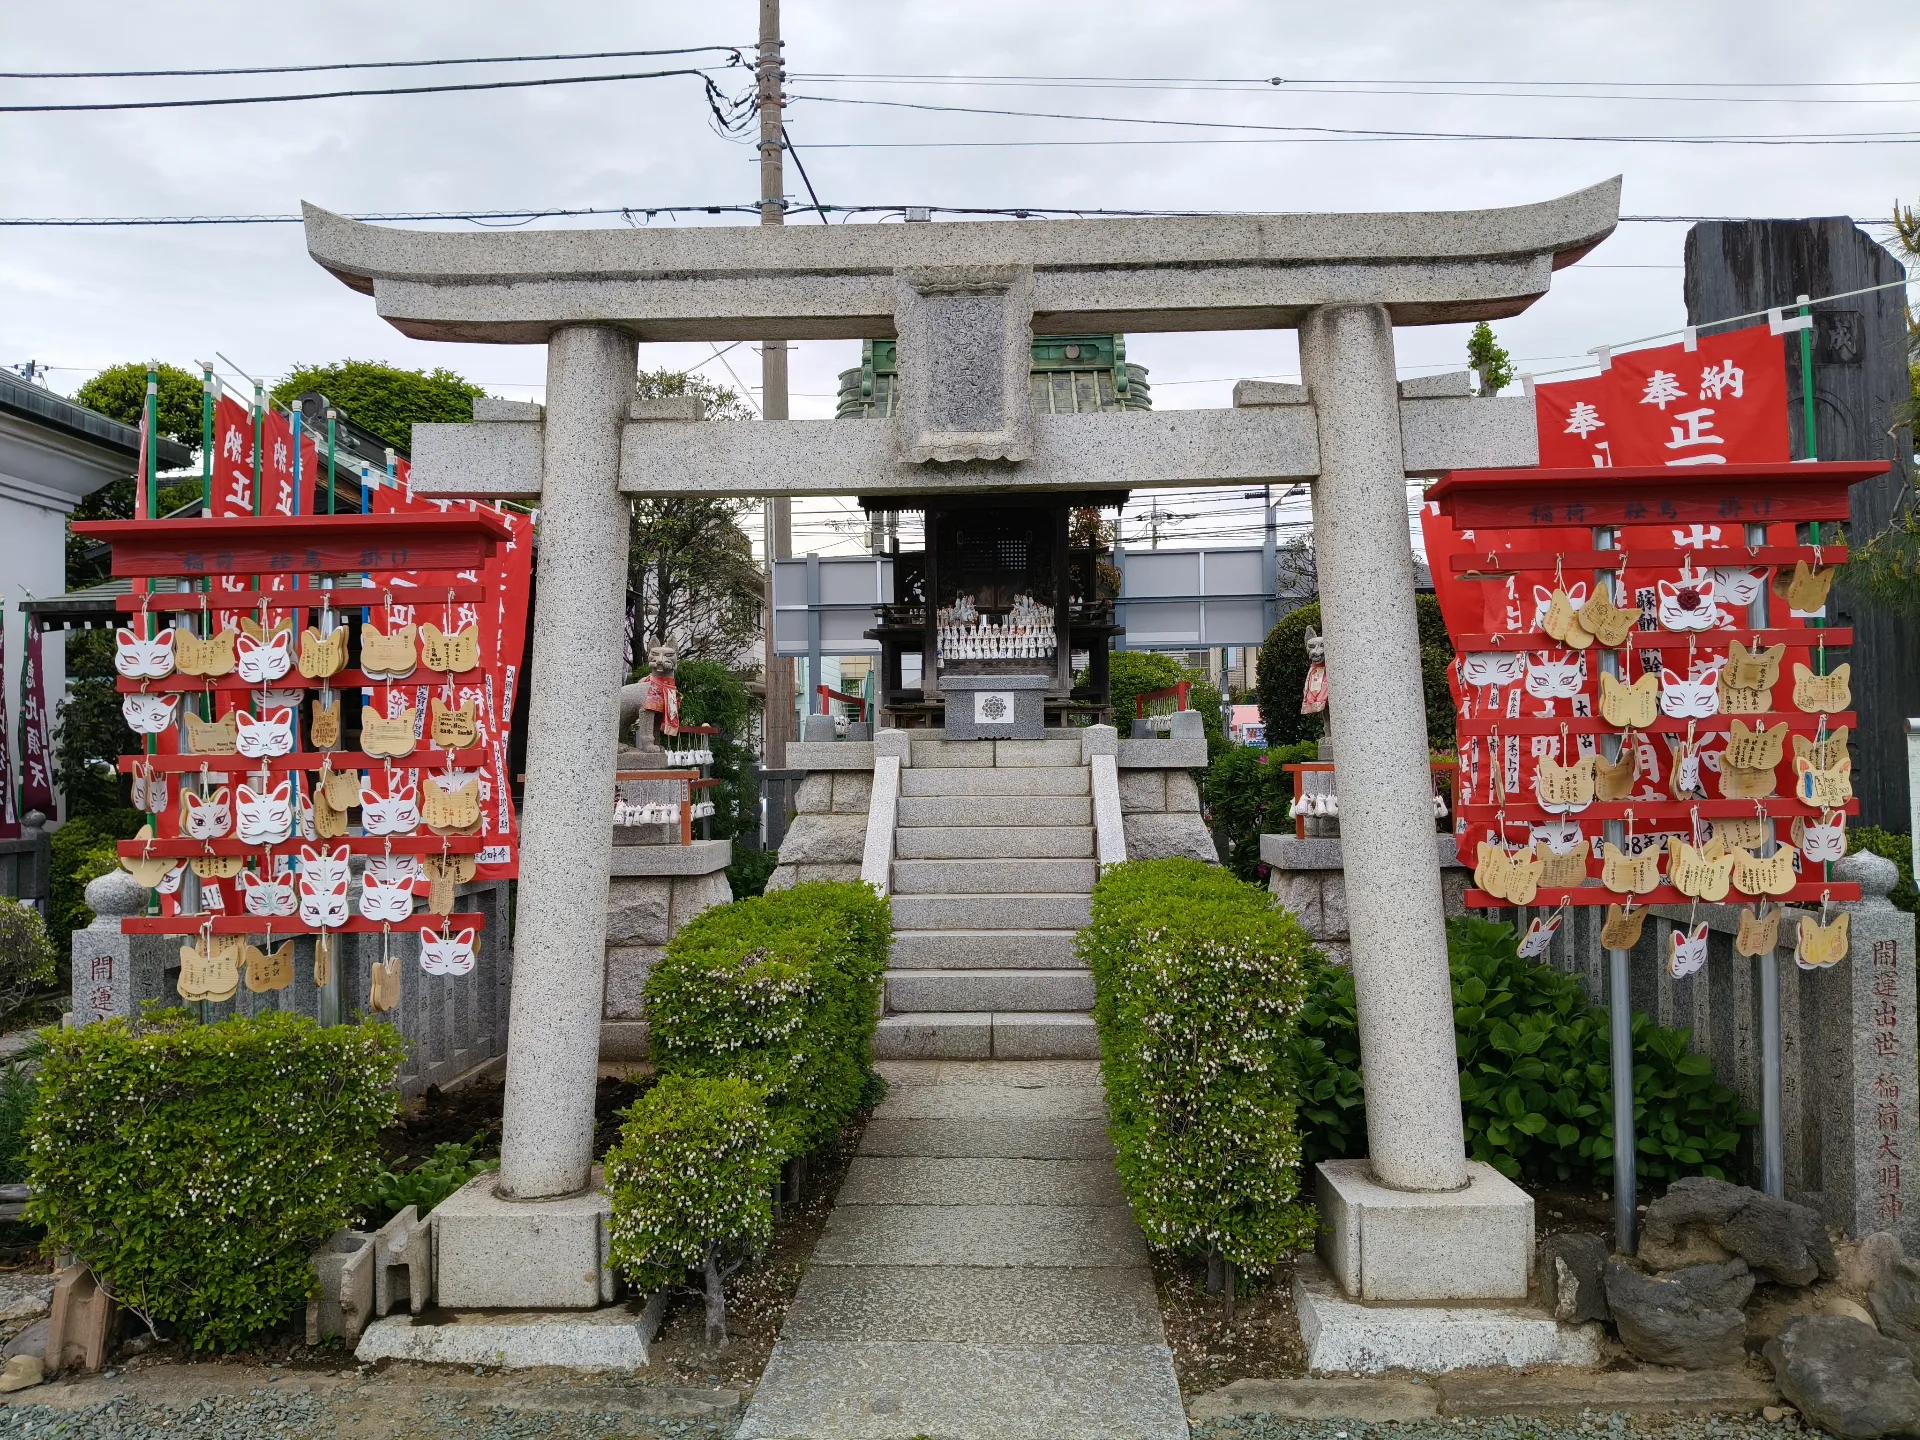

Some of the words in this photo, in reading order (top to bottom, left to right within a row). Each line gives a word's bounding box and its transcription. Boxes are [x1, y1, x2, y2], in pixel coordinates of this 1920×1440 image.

[1639, 359, 1744, 410] 奉納
[1528, 503, 1585, 523] 稲荷
[1624, 501, 1678, 520] 絵馬
[183, 551, 233, 572] 稲荷
[269, 548, 323, 570] 絵馬
[91, 955, 114, 1022] 開運
